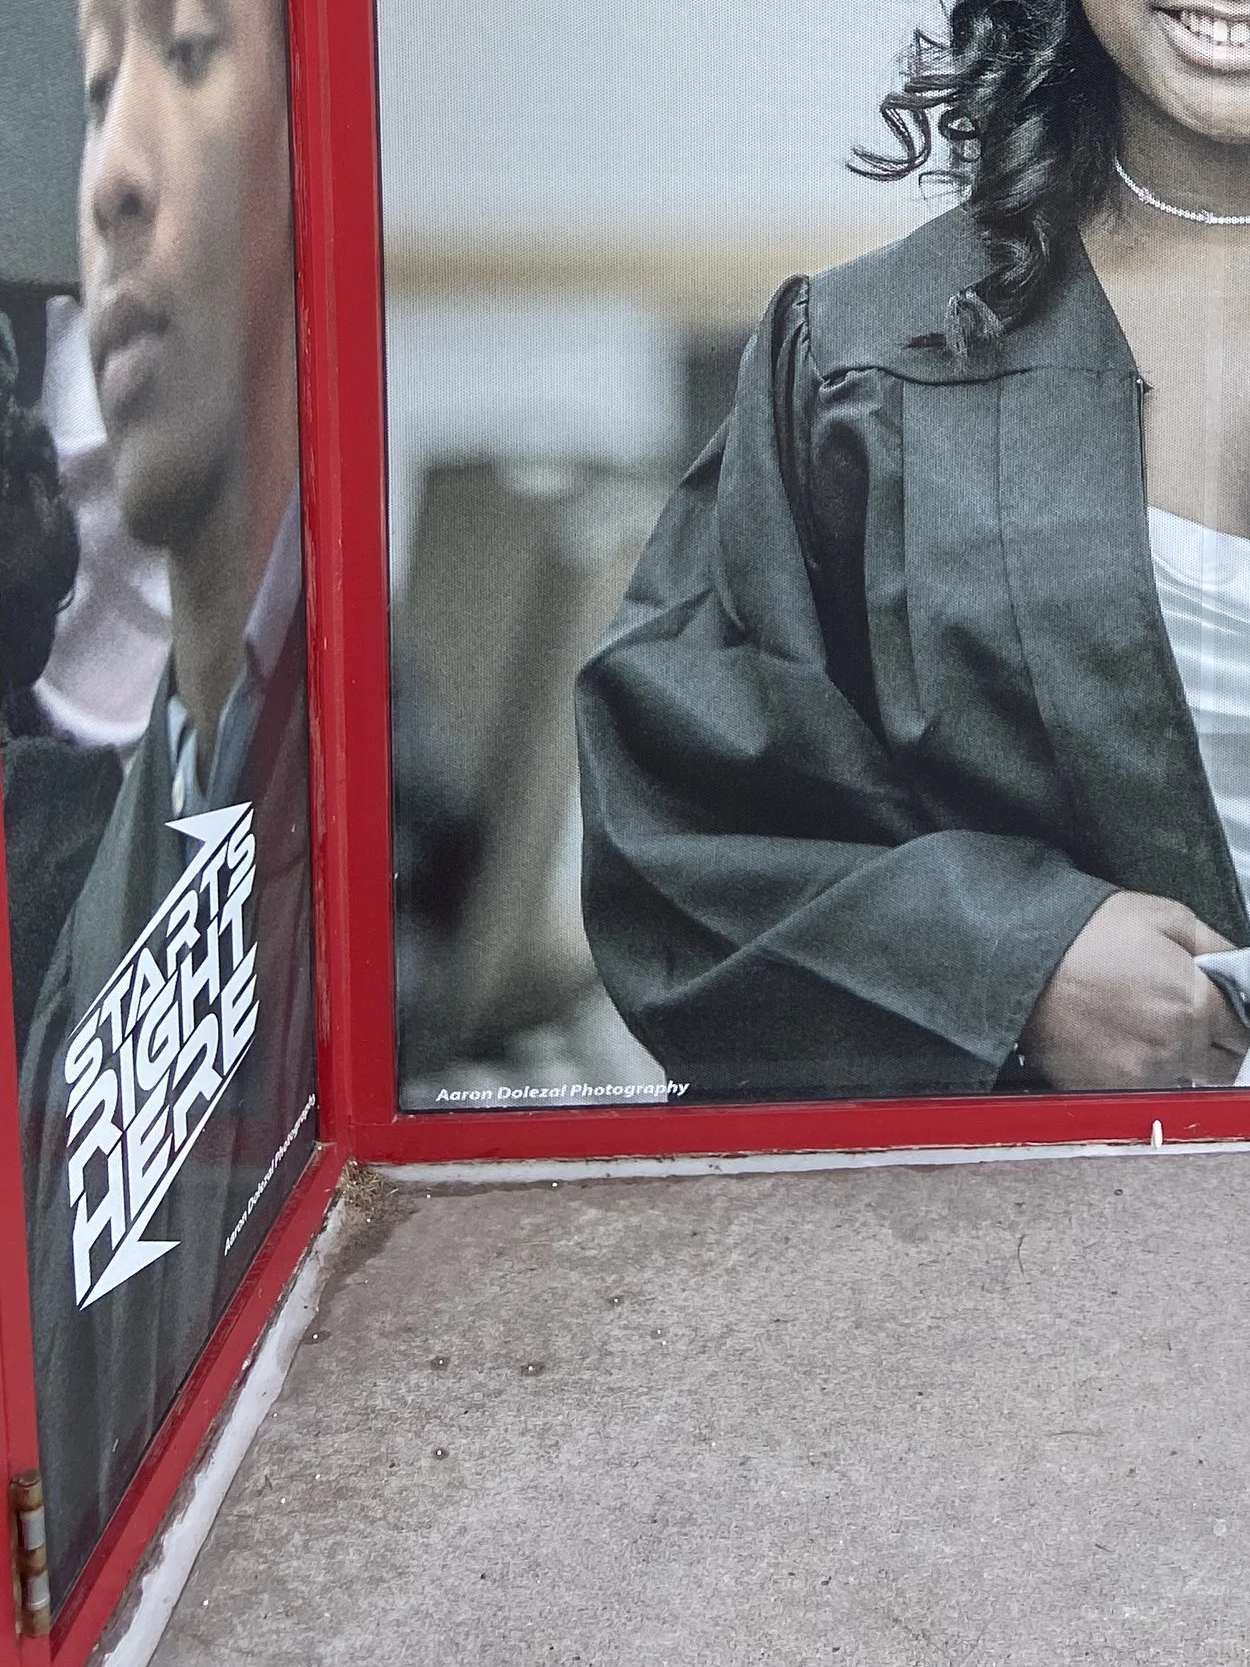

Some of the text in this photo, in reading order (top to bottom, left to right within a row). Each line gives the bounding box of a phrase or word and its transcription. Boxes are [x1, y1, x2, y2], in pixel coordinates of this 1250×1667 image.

[65, 808, 256, 1118] STARTS
[66, 864, 256, 1208] RIGHT
[435, 1080, 690, 1102] Aaron Dolezal Photography
[73, 941, 260, 1307] HERE
[224, 1210, 247, 1256] Aaron
[274, 1093, 315, 1168] Photography
